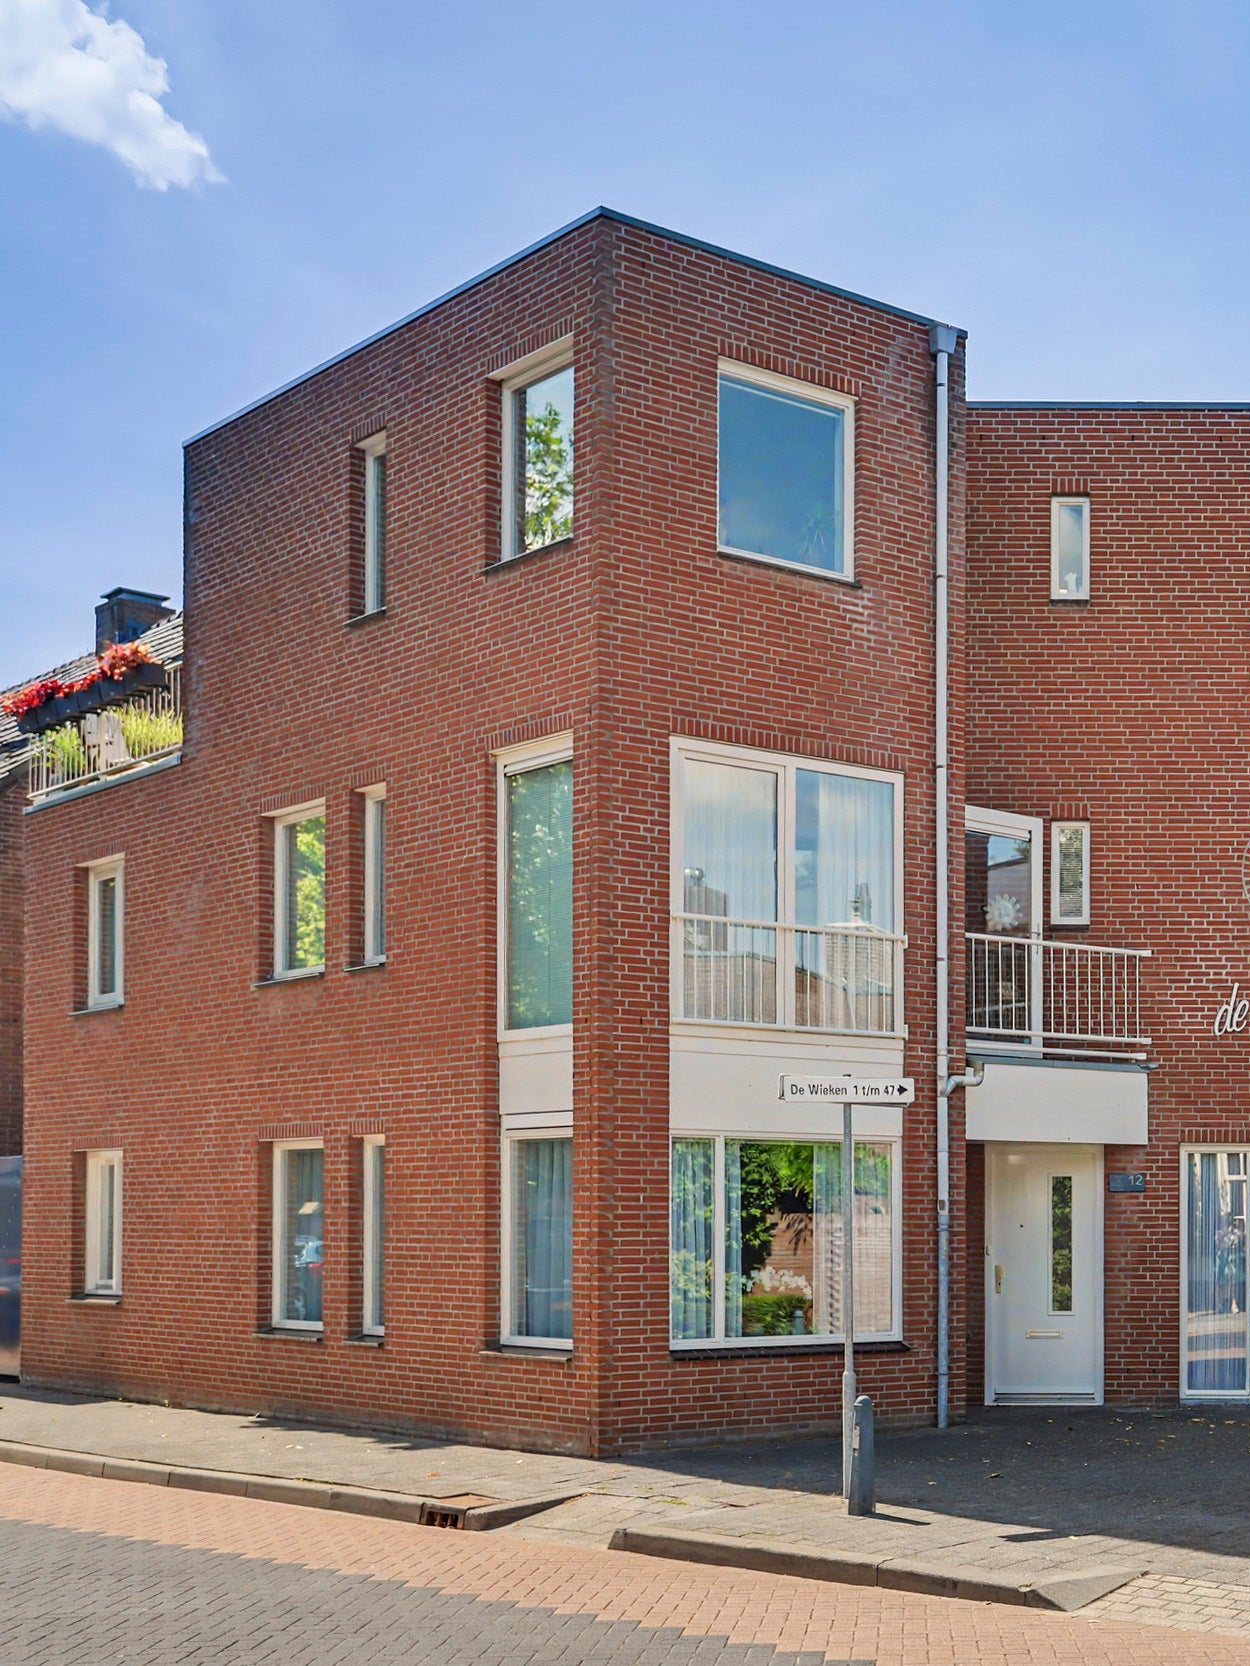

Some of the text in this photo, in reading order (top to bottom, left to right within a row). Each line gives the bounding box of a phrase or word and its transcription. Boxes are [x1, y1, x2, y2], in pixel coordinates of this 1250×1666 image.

[1213, 982, 1250, 1036] de
[790, 1084, 895, 1097] De Wieken 1 t/m 47
[1128, 1174, 1143, 1186] 12
